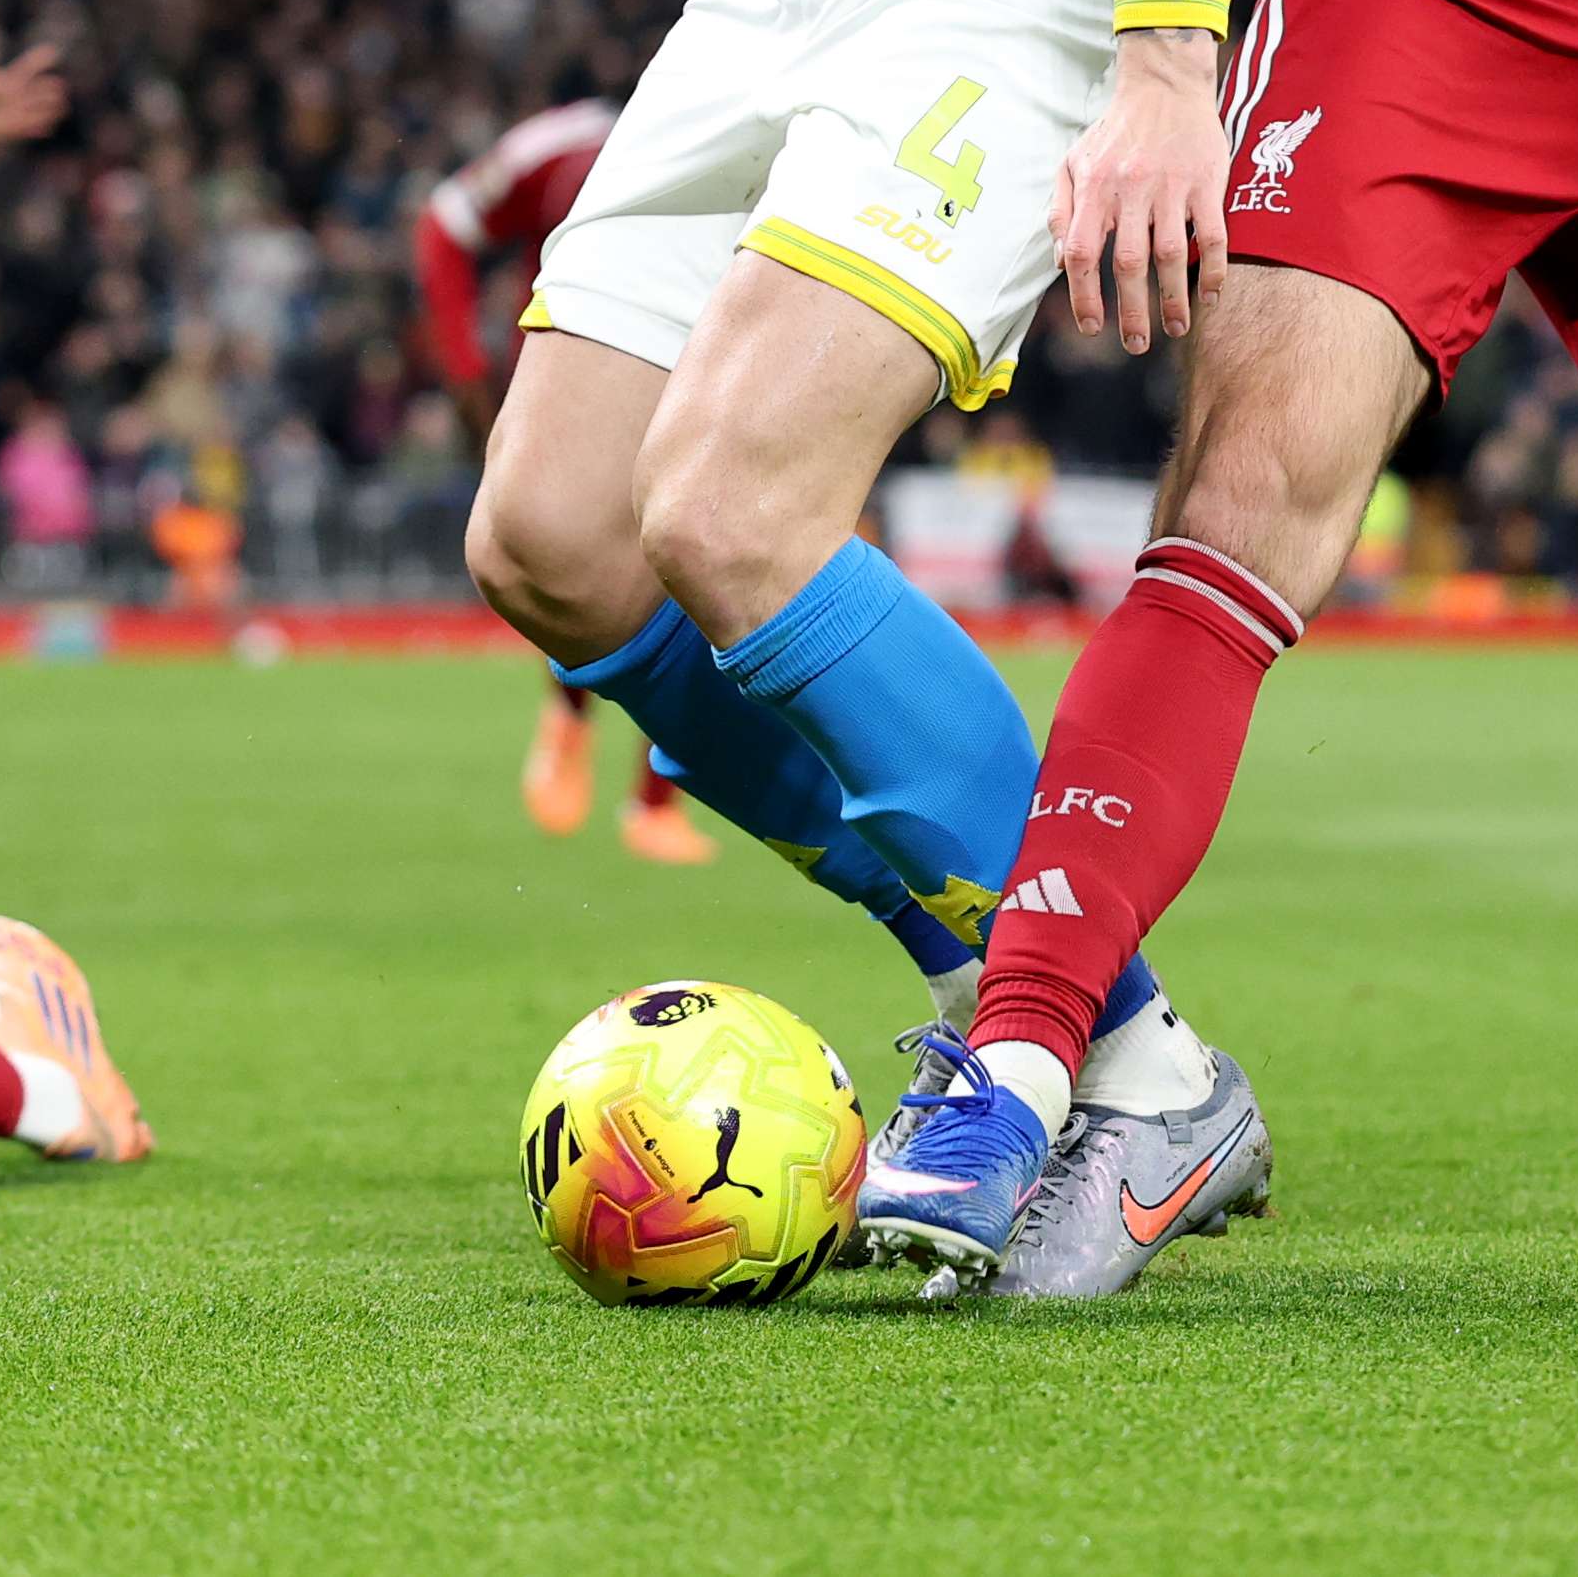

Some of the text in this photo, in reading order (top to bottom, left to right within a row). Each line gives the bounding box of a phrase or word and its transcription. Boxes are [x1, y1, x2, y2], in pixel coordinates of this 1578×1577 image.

[893, 74, 989, 230] 4
[853, 203, 954, 265] SUDU
[1027, 786, 1133, 829] LFC
[628, 1110, 675, 1178] Premier League
